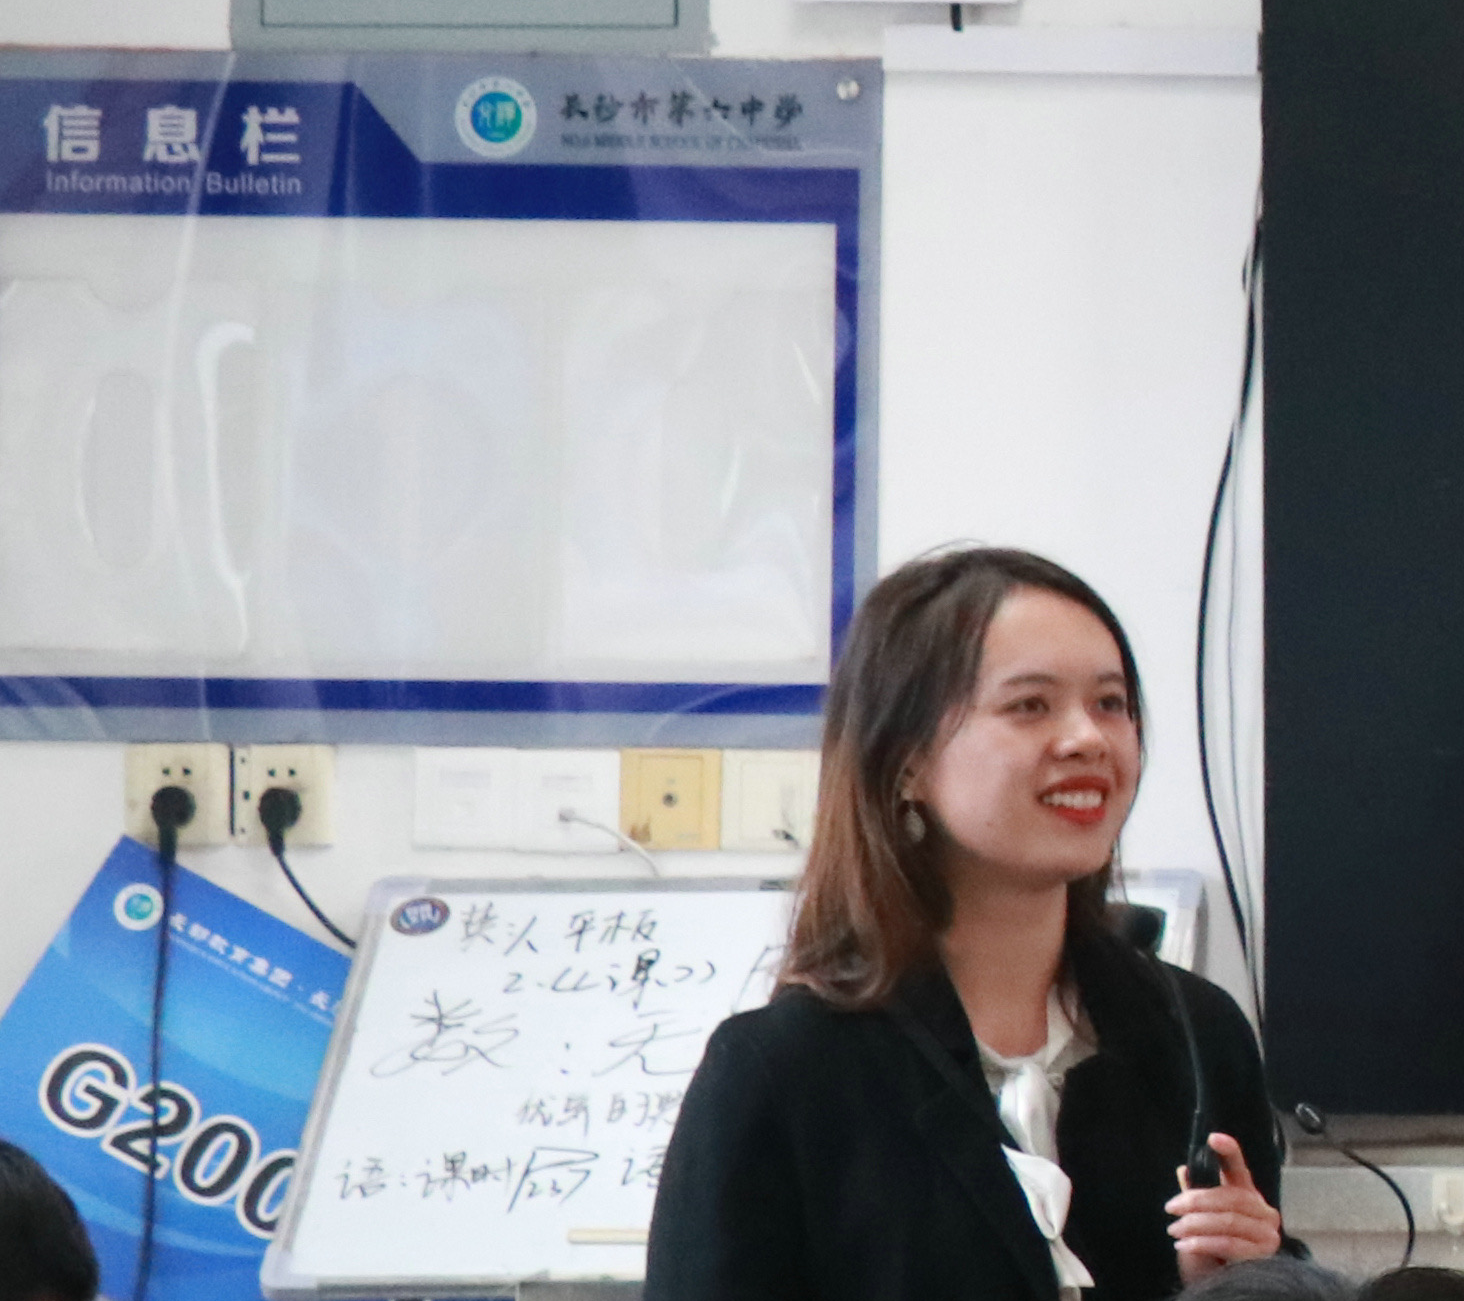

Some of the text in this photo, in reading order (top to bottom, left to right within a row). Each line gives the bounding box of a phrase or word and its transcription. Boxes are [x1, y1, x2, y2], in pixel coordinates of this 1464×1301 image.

[43, 105, 300, 165] 信息栏
[46, 171, 302, 195] Information Bulletin
